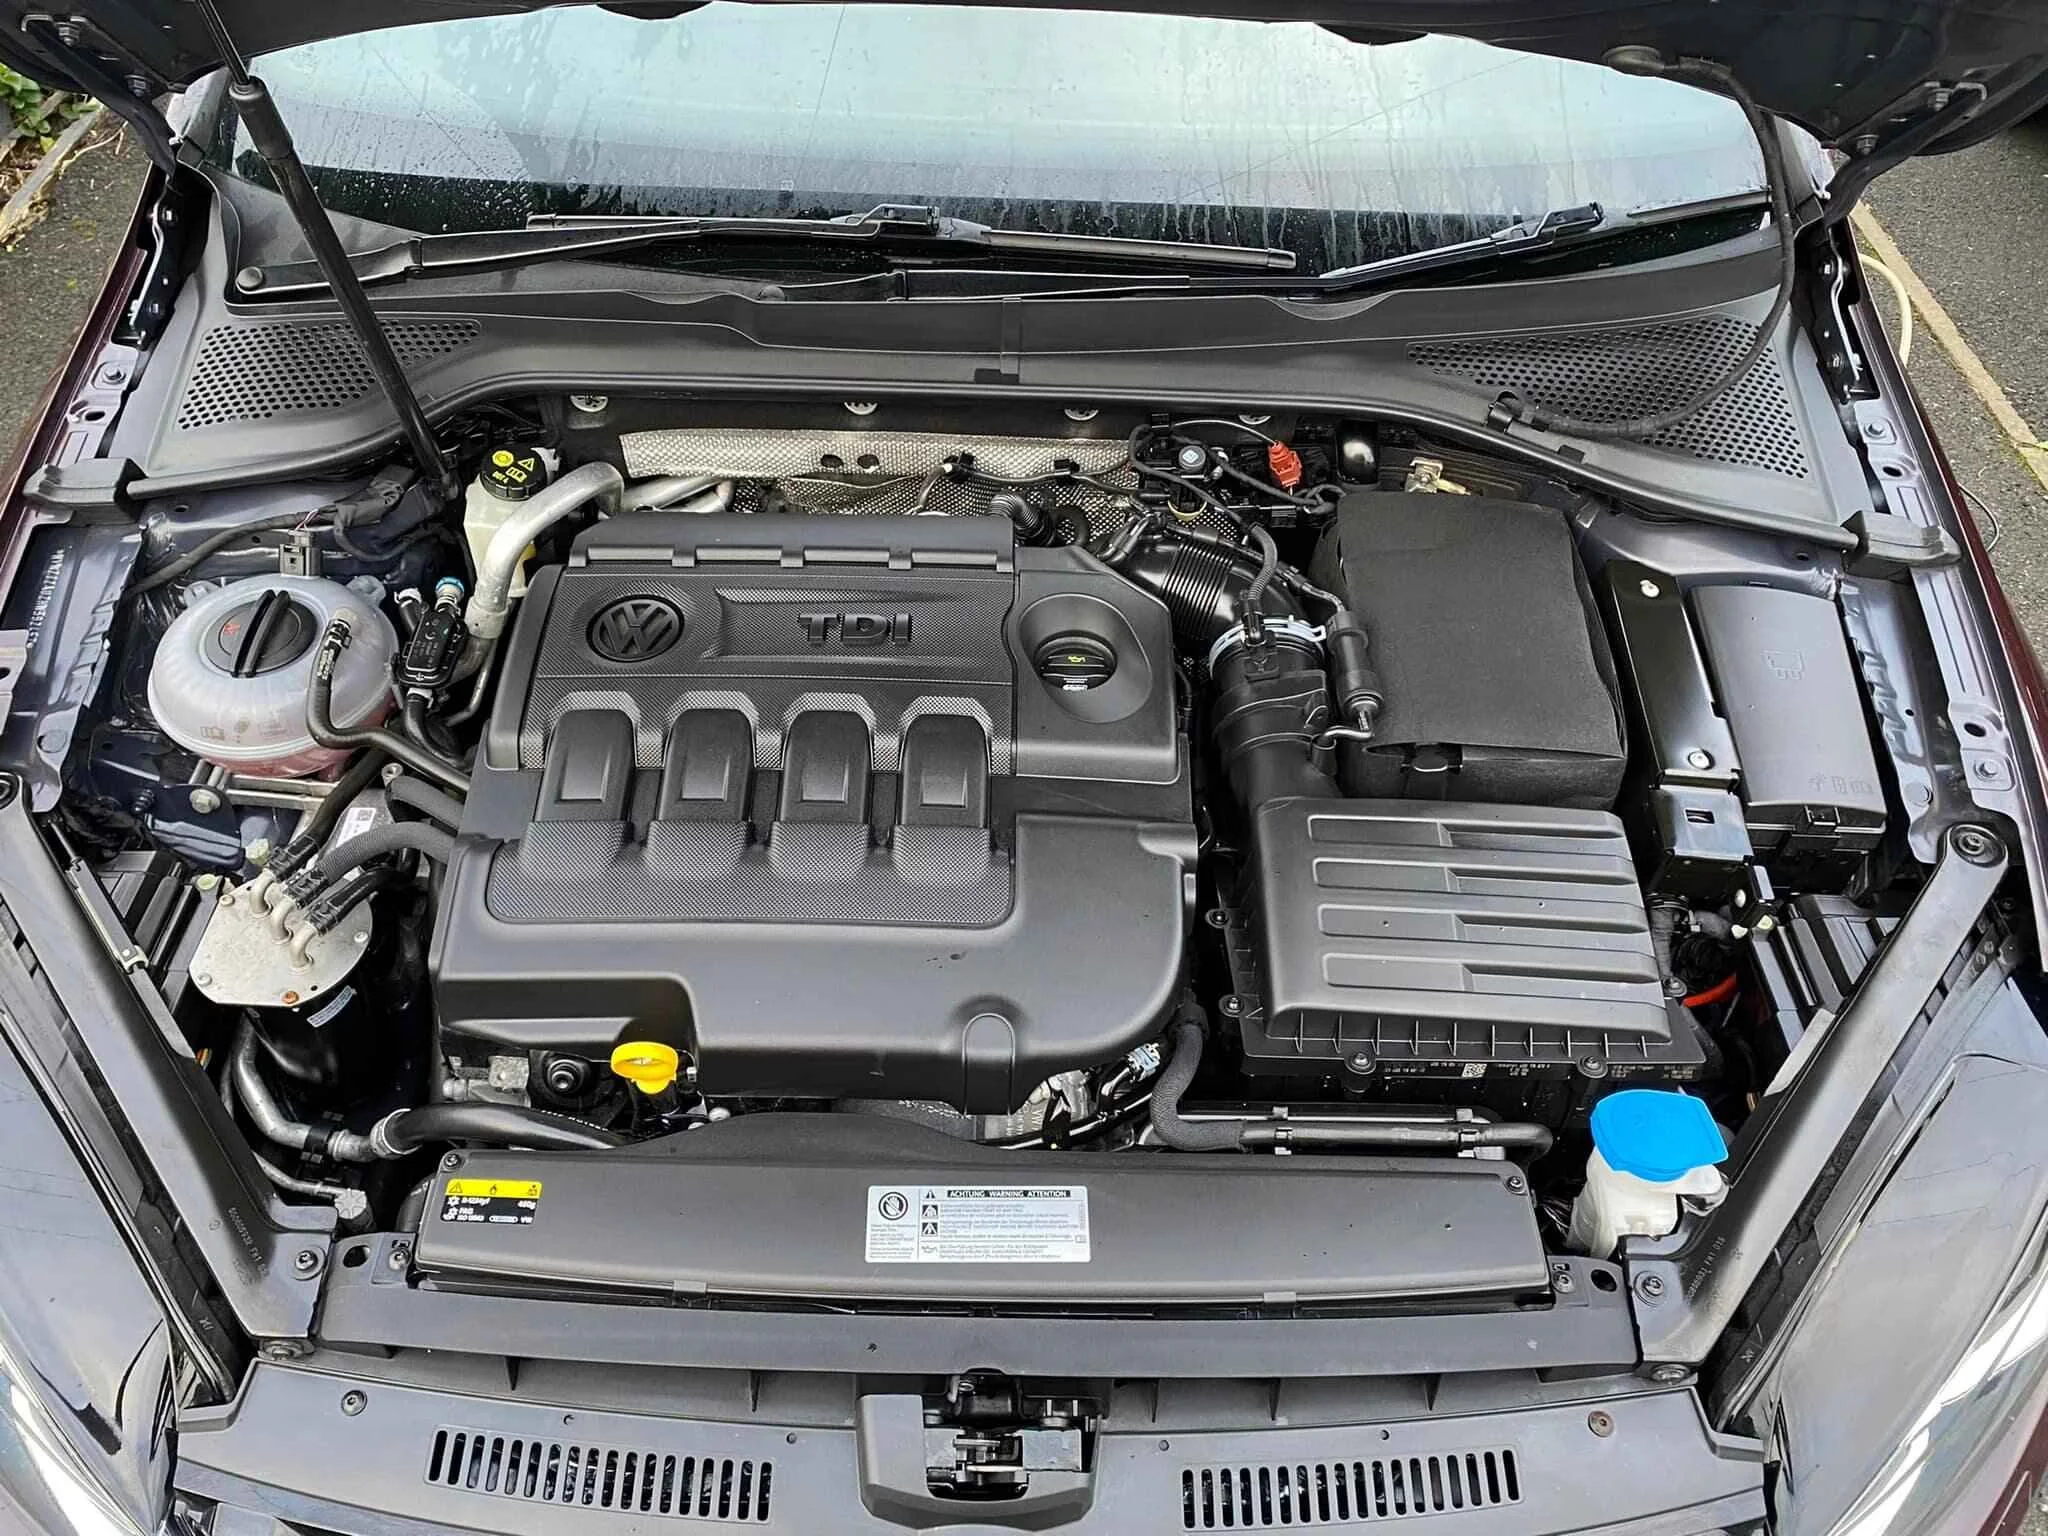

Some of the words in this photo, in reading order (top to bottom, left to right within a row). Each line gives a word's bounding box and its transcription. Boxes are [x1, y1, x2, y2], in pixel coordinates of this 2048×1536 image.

[588, 595, 682, 662] VW
[797, 613, 912, 647] TDI
[950, 1190, 985, 1198] ACHTUNG
[989, 1190, 1024, 1198] WARNING
[1027, 1190, 1067, 1198] ATTENTION
